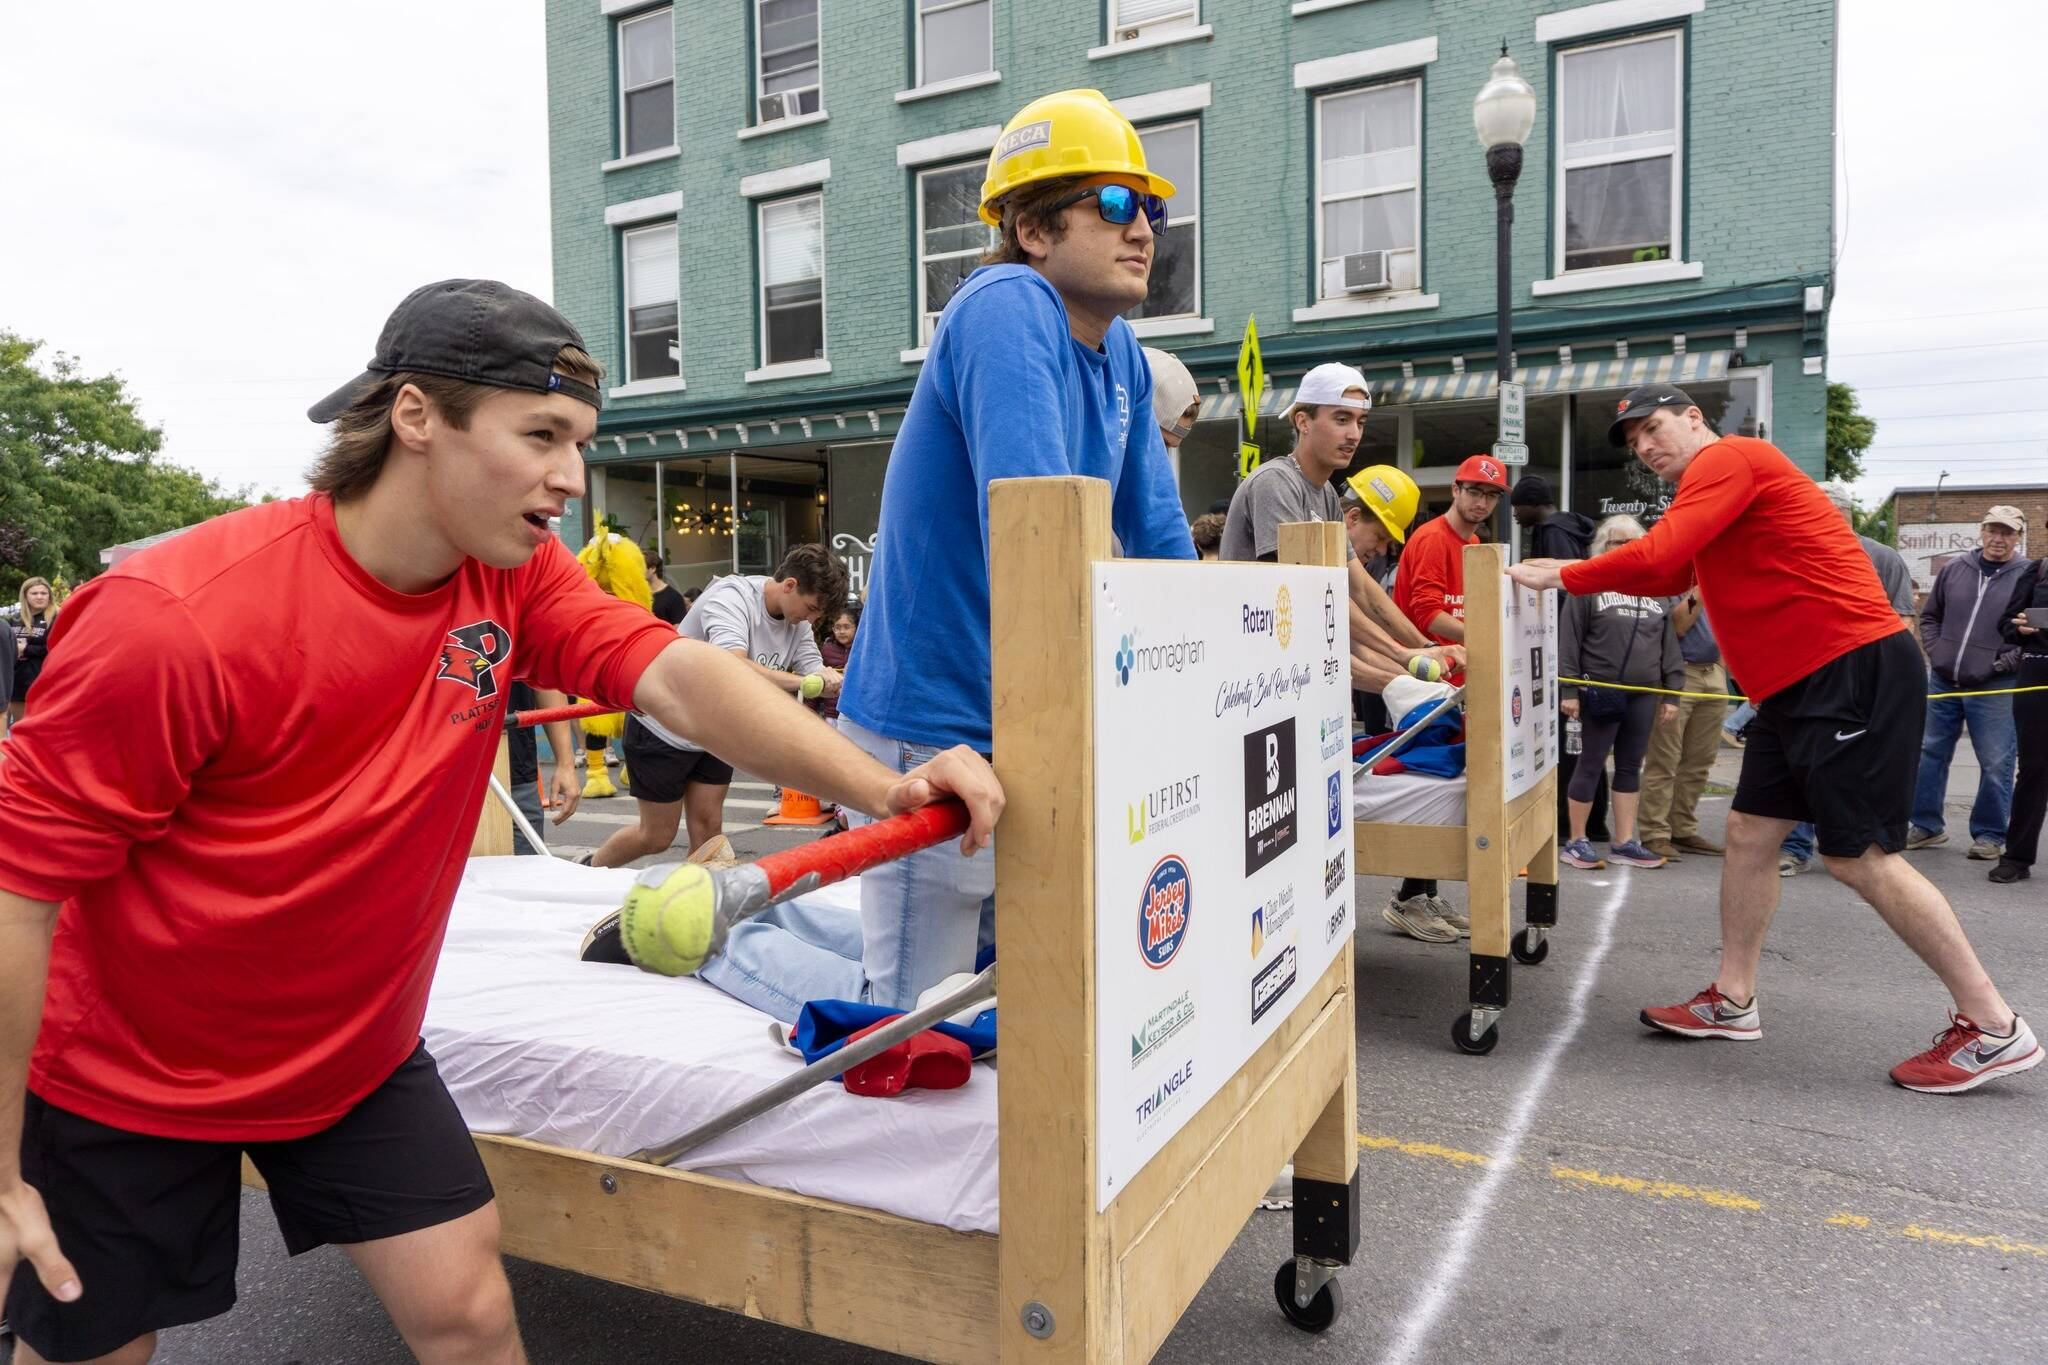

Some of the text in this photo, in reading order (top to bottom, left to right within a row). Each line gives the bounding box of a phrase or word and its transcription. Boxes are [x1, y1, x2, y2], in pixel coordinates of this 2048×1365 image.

[1599, 495, 1674, 517] Twenty-Si
[1900, 531, 1933, 549] Smith
[1242, 604, 1273, 637] Rotary
[1137, 634, 1204, 673] monaghan
[1253, 672, 1274, 708] Bed
[1149, 774, 1200, 818] UFIRST
[1249, 787, 1294, 839] BRENNAN
[1145, 878, 1185, 919] Jersey
[1158, 940, 1174, 959] SUBS
[1148, 989, 1189, 1027] MARTINDALE
